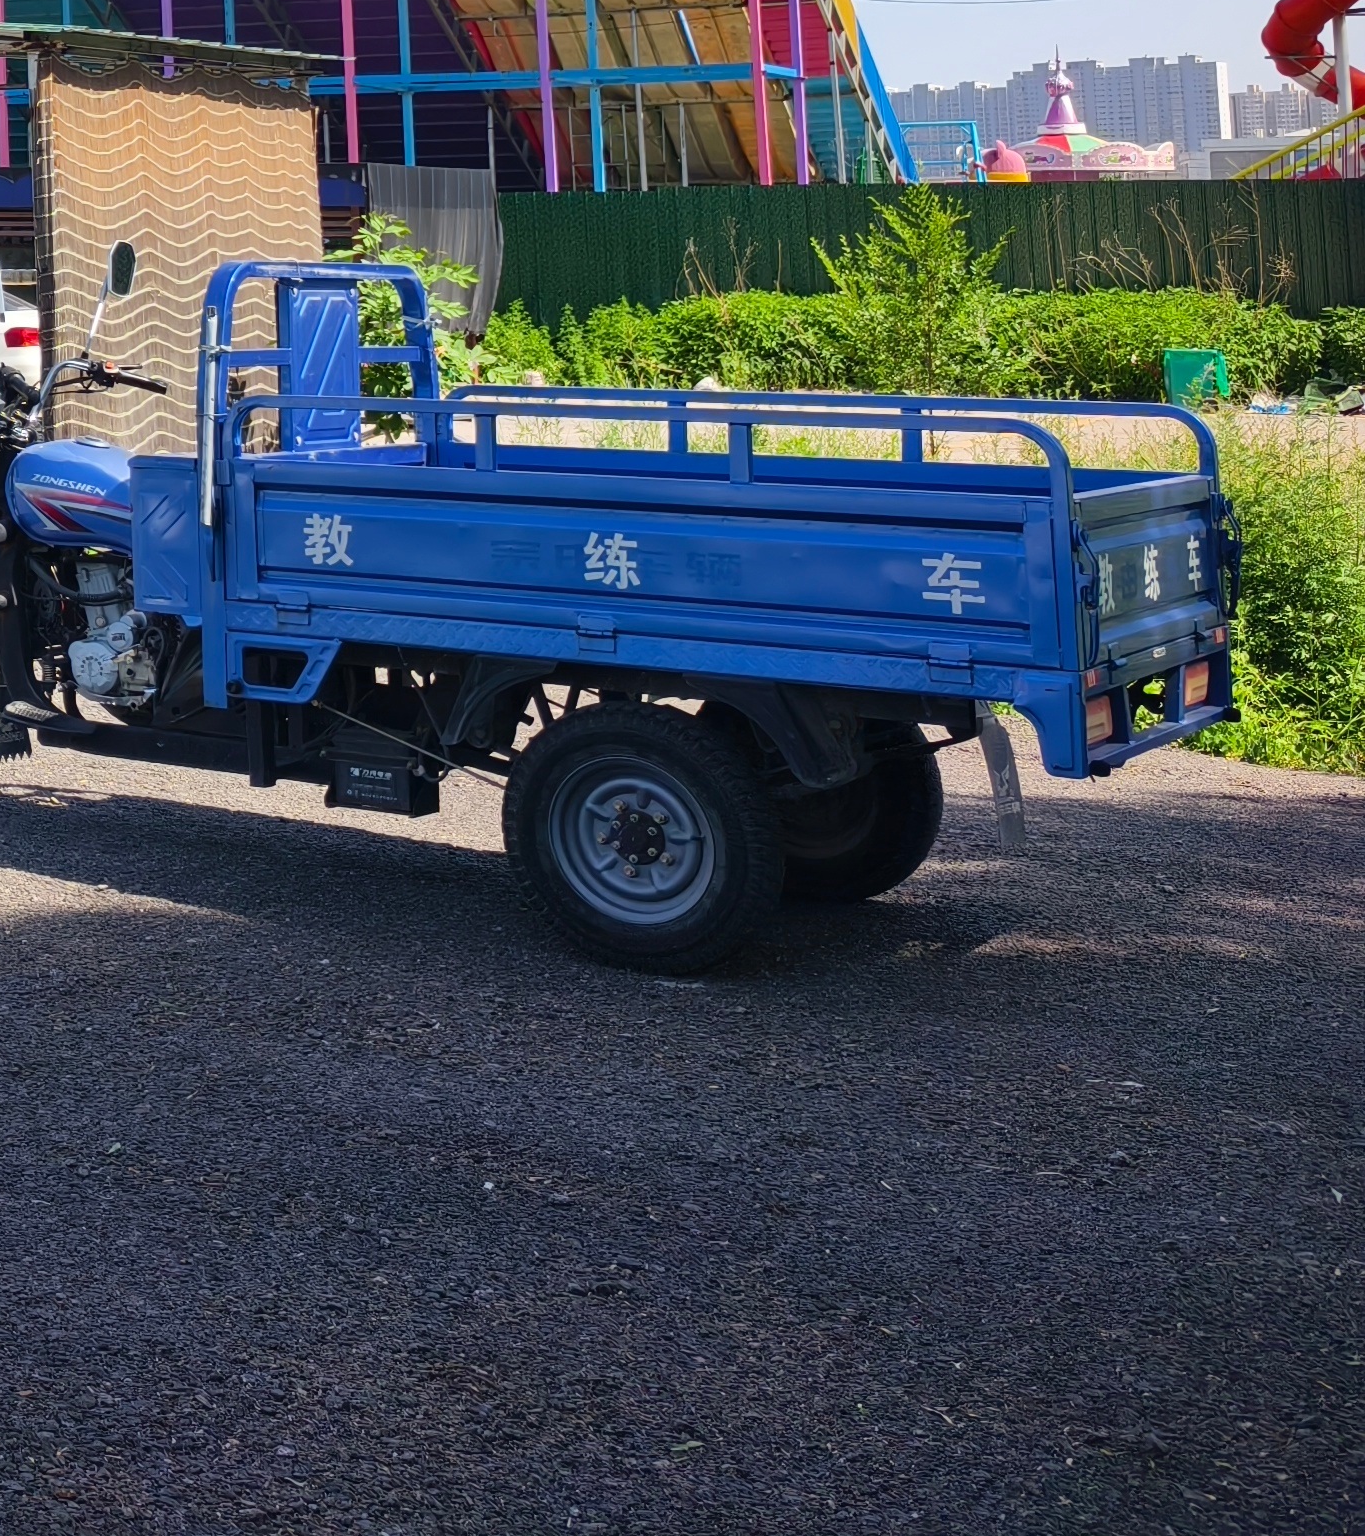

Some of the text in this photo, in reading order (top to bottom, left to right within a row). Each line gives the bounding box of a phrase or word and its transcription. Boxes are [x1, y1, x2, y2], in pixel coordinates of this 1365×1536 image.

[30, 473, 107, 497] ZONGSHEN
[302, 513, 986, 615] 教练车
[1098, 534, 1203, 615] 教练车
